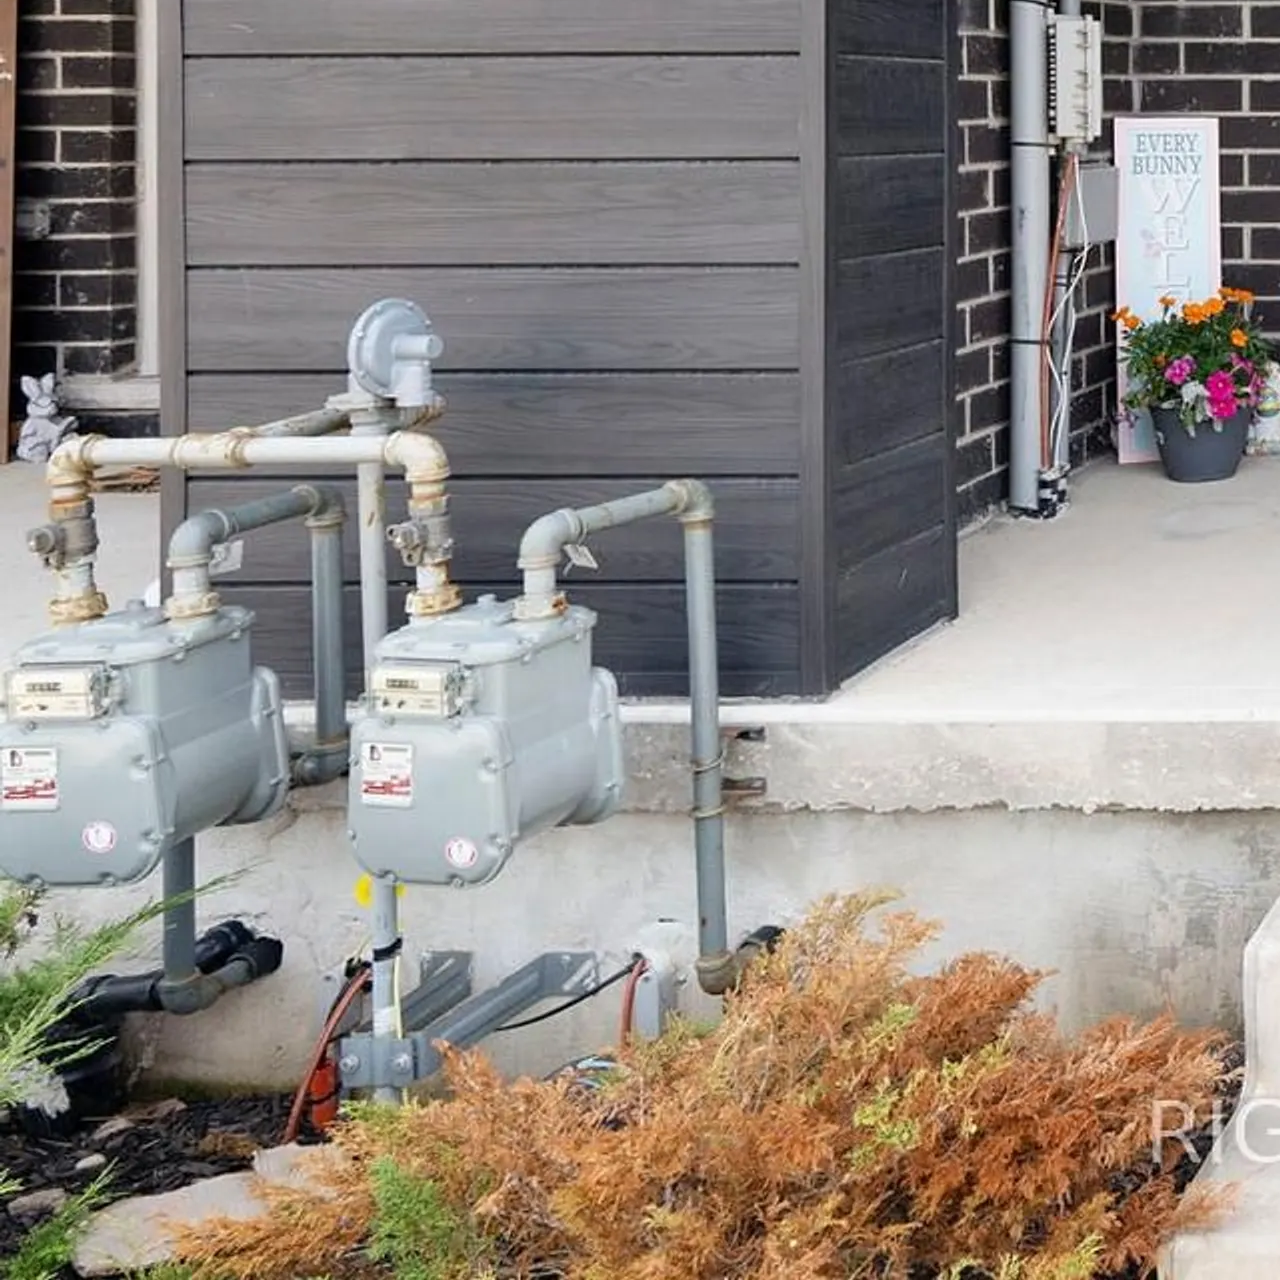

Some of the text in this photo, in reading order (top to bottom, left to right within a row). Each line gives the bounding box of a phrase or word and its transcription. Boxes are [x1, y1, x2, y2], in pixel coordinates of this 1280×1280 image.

[1136, 133, 1200, 153] EVERY
[1132, 156, 1201, 175] BUNNY
[1143, 177, 1200, 304] WEL
